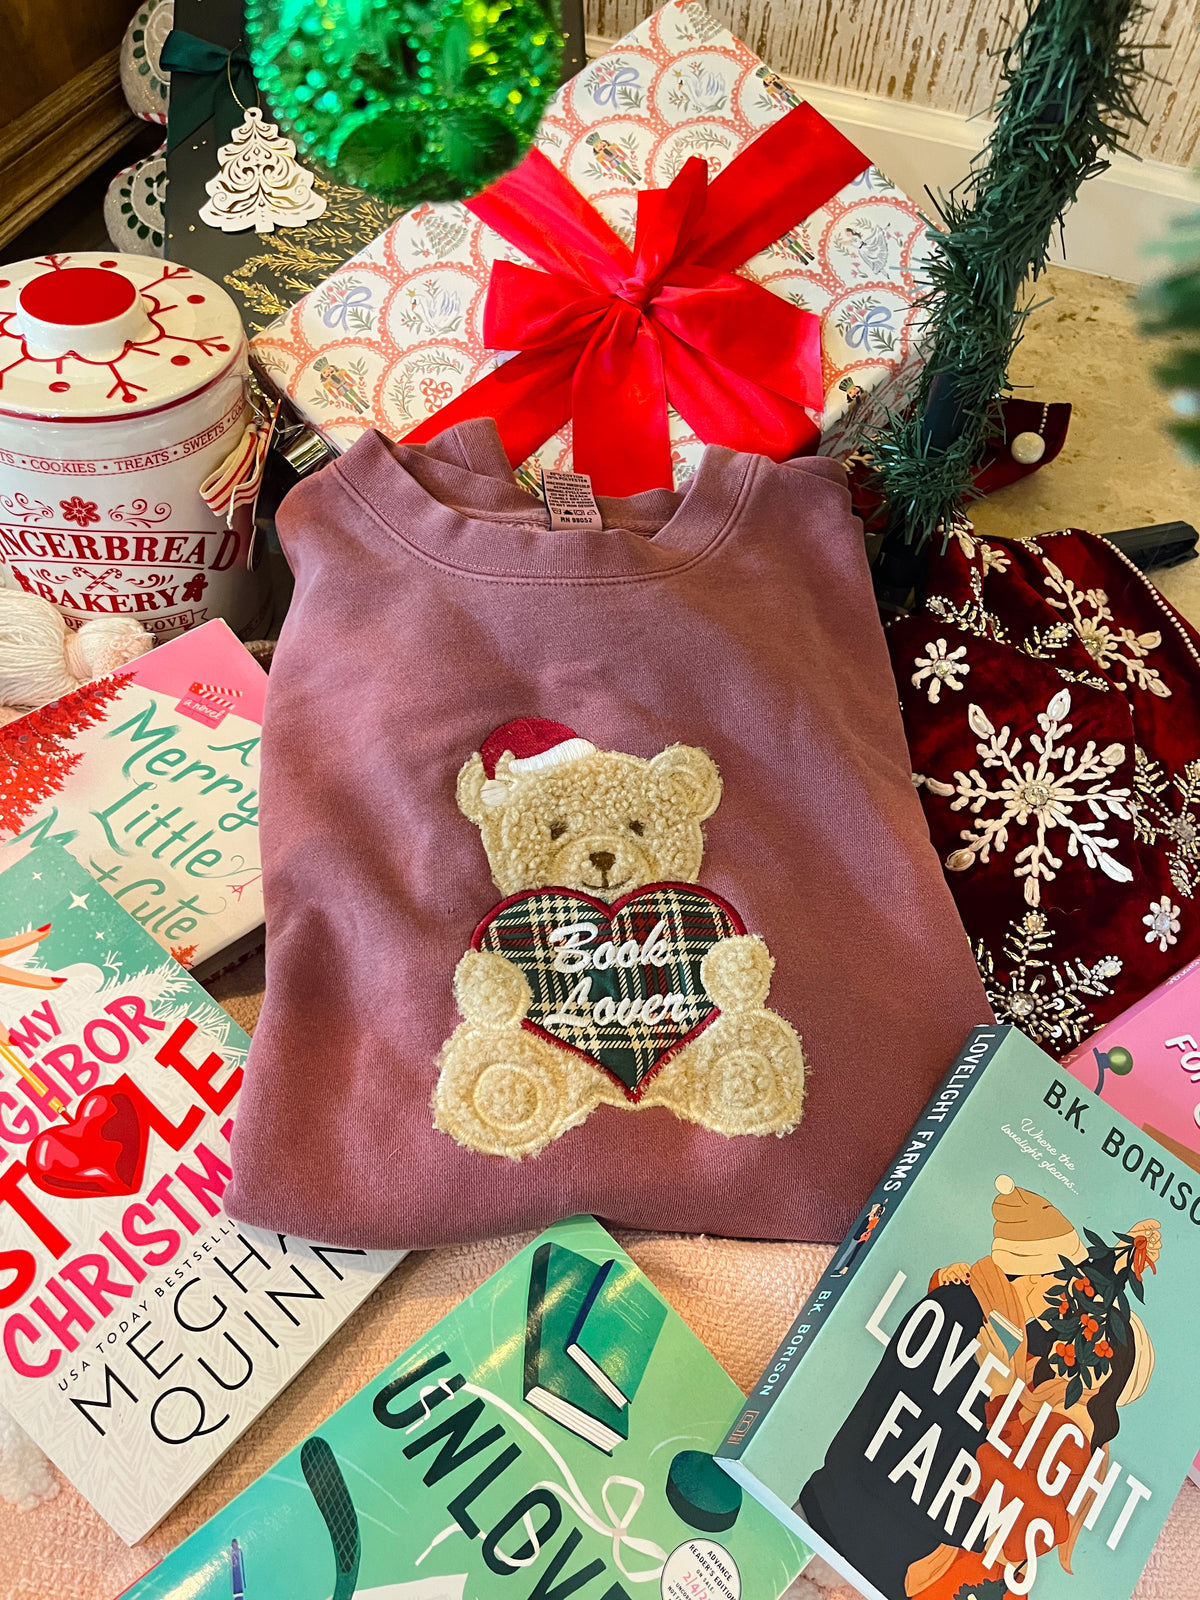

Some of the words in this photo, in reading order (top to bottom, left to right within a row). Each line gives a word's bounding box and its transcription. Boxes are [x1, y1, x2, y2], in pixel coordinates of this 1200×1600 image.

[30, 459, 97, 473] COOKIES
[114, 451, 169, 471] TREATS
[183, 422, 225, 454] SWEETS
[0, 528, 241, 571] NGERBREAD
[33, 579, 181, 613] BAKERY
[143, 614, 189, 632] LOVE
[183, 699, 193, 707] a
[192, 703, 226, 719] novel
[103, 699, 260, 832] Merry
[207, 737, 261, 767] A
[89, 781, 223, 878] Little
[112, 878, 211, 941] Cute
[549, 919, 671, 974] Book
[8, 998, 62, 1059] MY
[543, 976, 690, 1027] Lover
[0, 995, 168, 1155] GHBOR
[927, 1033, 996, 1123] LOVELIGHT
[1043, 1079, 1090, 1134] B.K.
[883, 1131, 934, 1192] FARMS
[1000, 1124, 1043, 1160] lovelight
[1021, 1118, 1057, 1156] Where
[1058, 1153, 1075, 1171] the
[3, 1118, 235, 1378] CHRISTM
[58, 1360, 90, 1391] USA
[96, 1300, 149, 1354] TODAY
[154, 1219, 235, 1297] BESTSELLI
[807, 1290, 832, 1315] B.K.
[68, 1233, 288, 1435] MEGH
[150, 1246, 367, 1444] QUINN
[759, 1324, 811, 1396] BORISON
[865, 1270, 1152, 1551] LOVELIGHT
[372, 1351, 633, 1600] UNLOV
[864, 1390, 1055, 1595] FARMS
[683, 1571, 712, 1600] 2/4/2
[689, 1544, 715, 1577] READER'S
[713, 1576, 737, 1600] EDITION
[707, 1550, 733, 1582] ADVANCE
